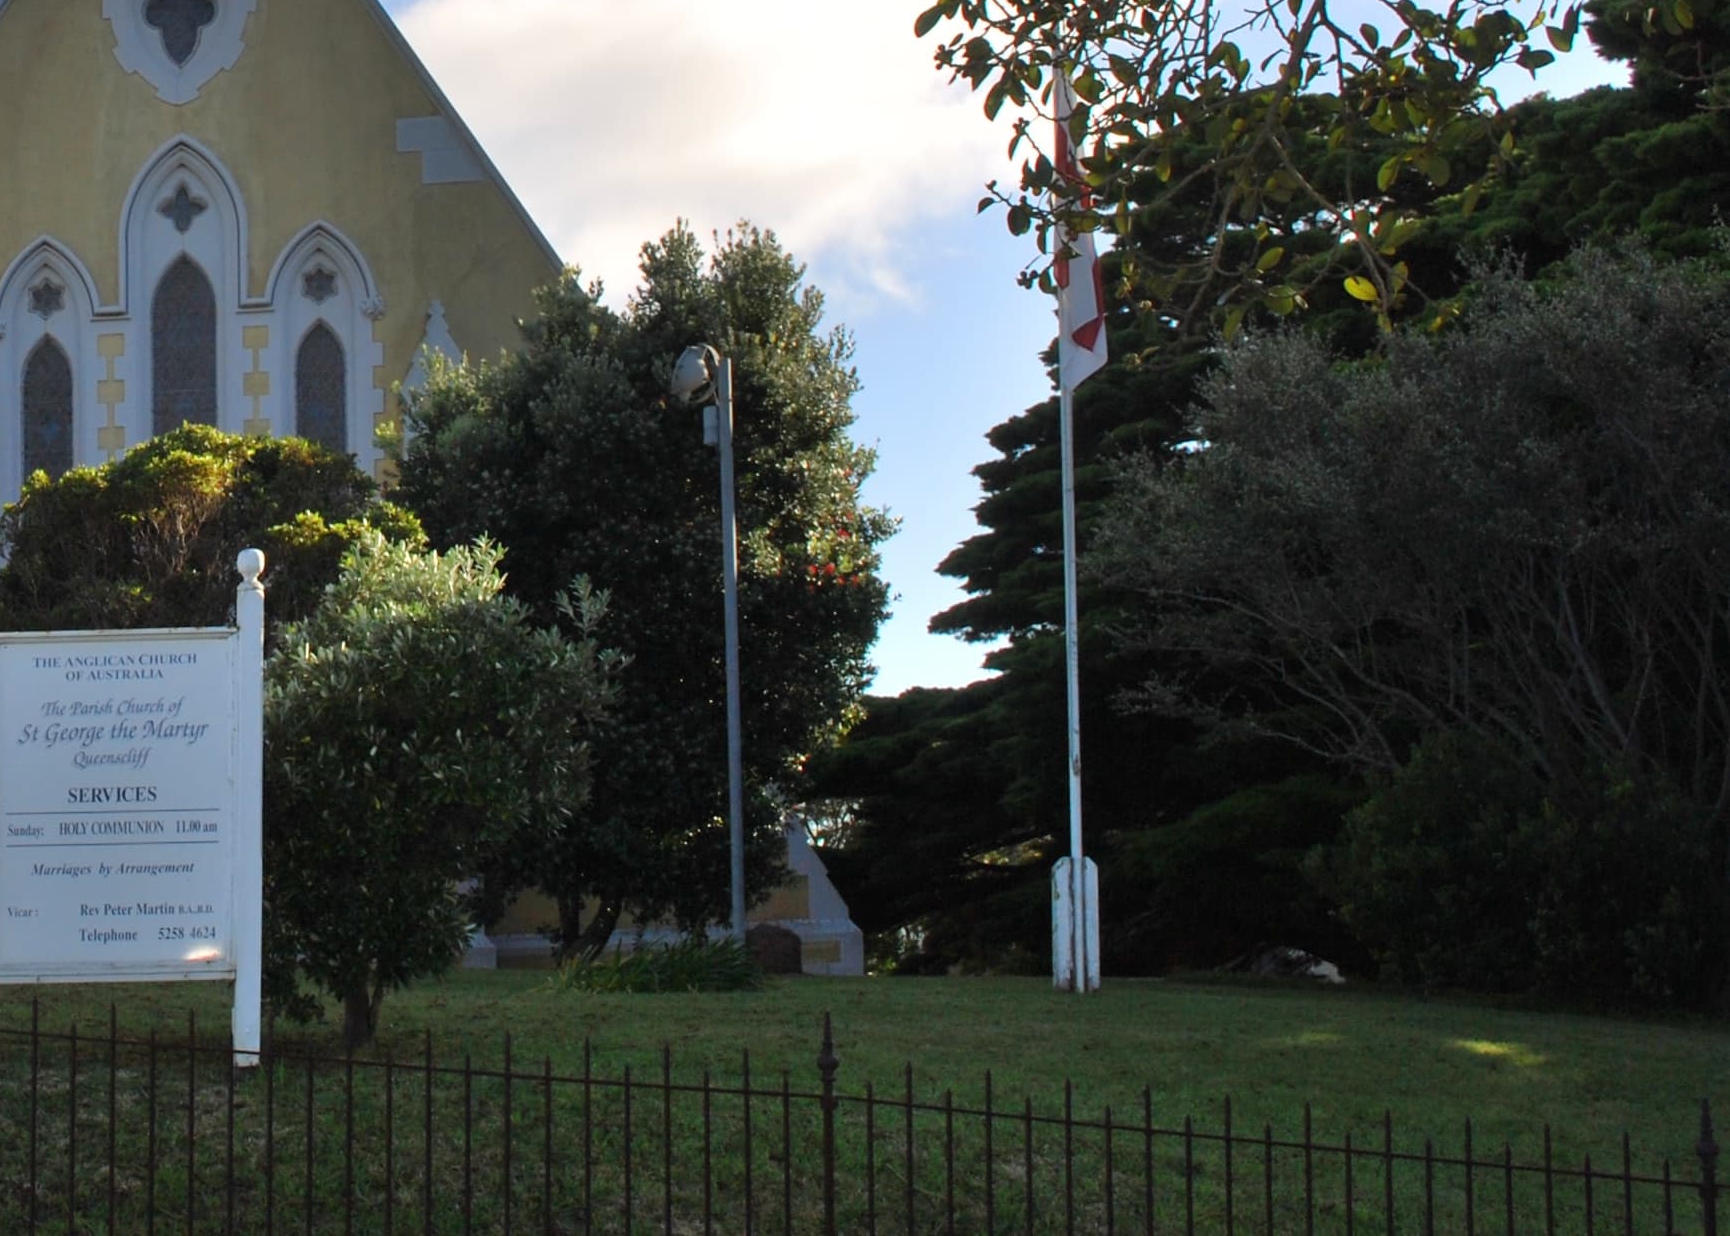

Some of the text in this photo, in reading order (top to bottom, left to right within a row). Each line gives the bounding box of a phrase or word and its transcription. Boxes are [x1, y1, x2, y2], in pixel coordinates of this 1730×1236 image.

[33, 653, 197, 668] THE ANGLICAN CHURCH
[65, 668, 164, 681] OF AUSTRALIA
[41, 696, 183, 717] The Parish Church of
[18, 717, 209, 748] St George the Martyr
[73, 748, 151, 769] Queenscliff
[68, 786, 158, 804] SERVICES
[6, 820, 218, 840] Sunday: HOLY COMMUNION 11.00 am
[30, 862, 194, 878] Marriages by Arrangement
[80, 904, 100, 916] Rev
[104, 902, 134, 916] Peter
[136, 902, 174, 916] Martin
[78, 926, 216, 944] Telephone 5258 4624
